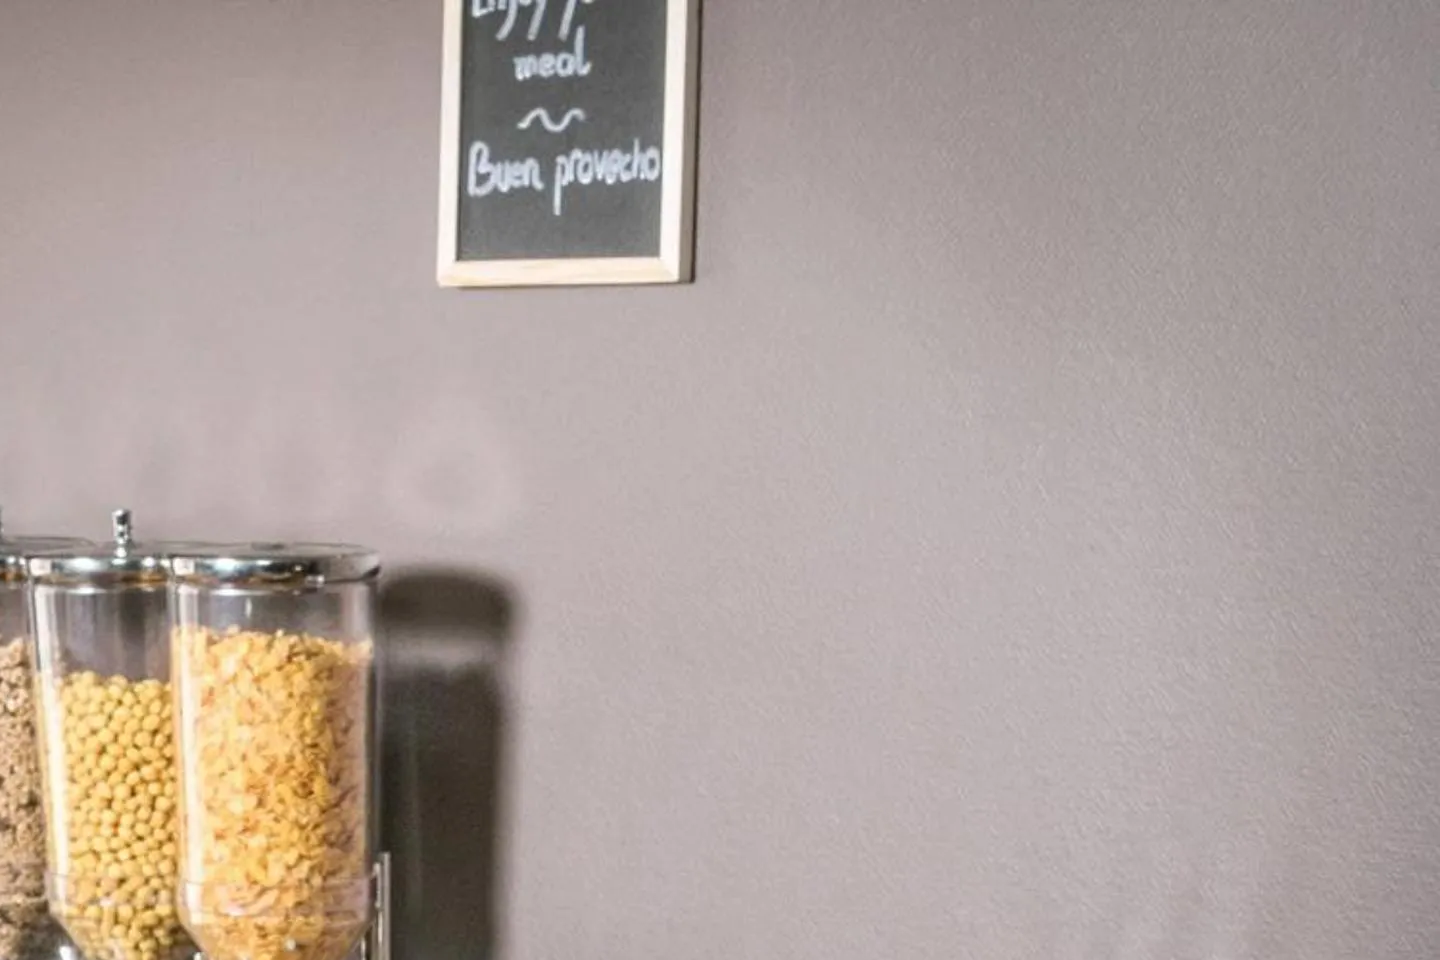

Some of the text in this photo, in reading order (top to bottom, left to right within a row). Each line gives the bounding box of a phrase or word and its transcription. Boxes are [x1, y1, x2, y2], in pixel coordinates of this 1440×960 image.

[513, 25, 592, 81] meal
[467, 138, 661, 216] Buen provecho
